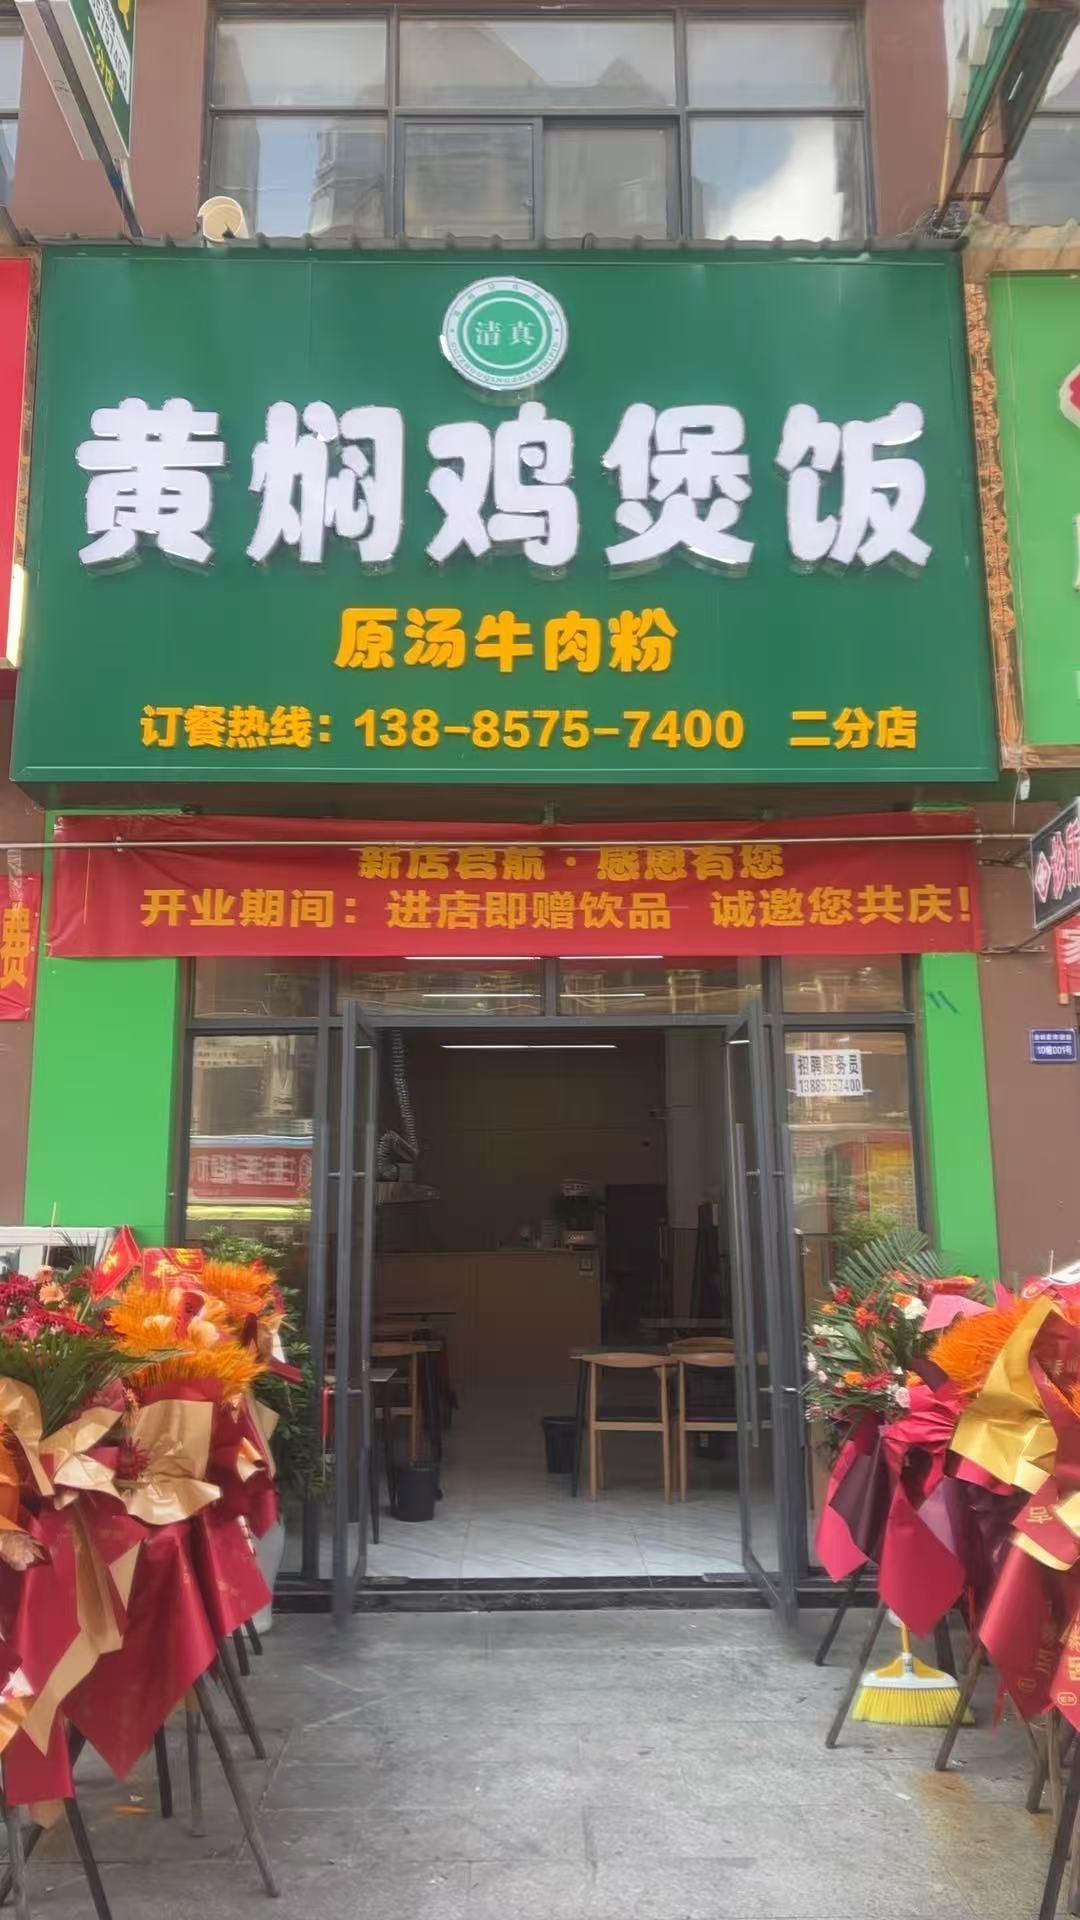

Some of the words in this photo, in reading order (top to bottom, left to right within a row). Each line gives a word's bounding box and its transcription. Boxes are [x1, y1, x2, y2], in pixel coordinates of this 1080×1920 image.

[475, 321, 535, 346] 清真
[75, 397, 932, 567] 黄焖鸡煲饭
[334, 607, 678, 673] 原汤牛肉粉
[789, 706, 917, 749] 二分店
[710, 884, 971, 928] 诚邀您共庆！
[797, 1054, 859, 1075] 招聘服务员
